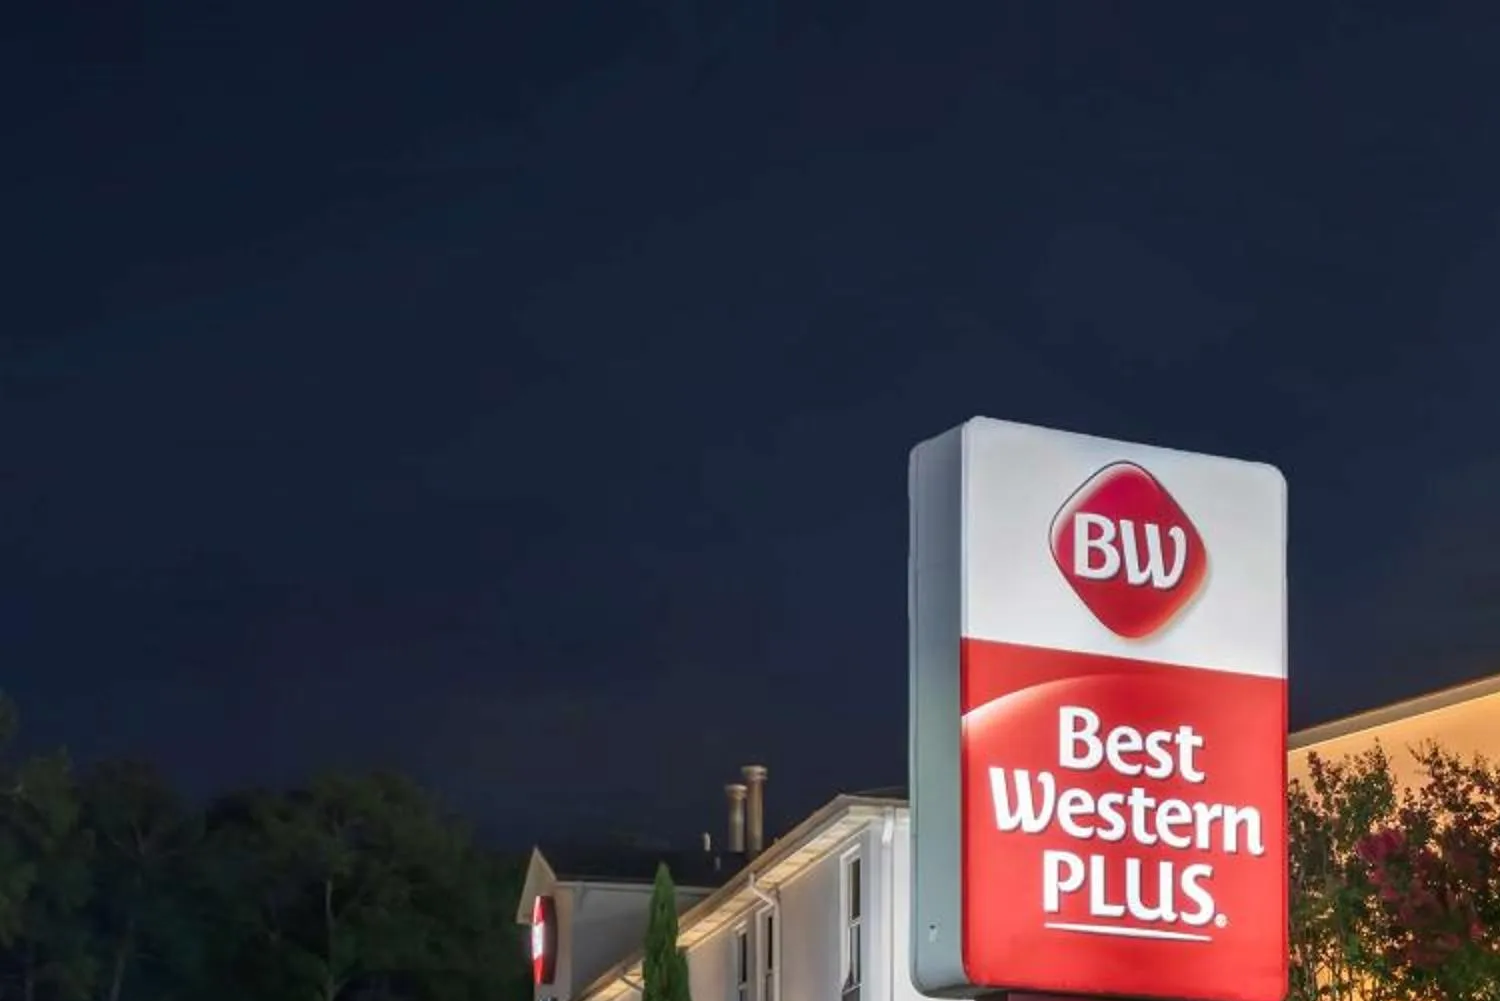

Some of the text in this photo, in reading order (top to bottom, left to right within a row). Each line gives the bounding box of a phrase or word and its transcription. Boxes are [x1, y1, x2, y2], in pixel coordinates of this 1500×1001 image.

[1073, 511, 1188, 589] BW
[1058, 705, 1205, 783] Best
[987, 765, 1265, 856] Western
